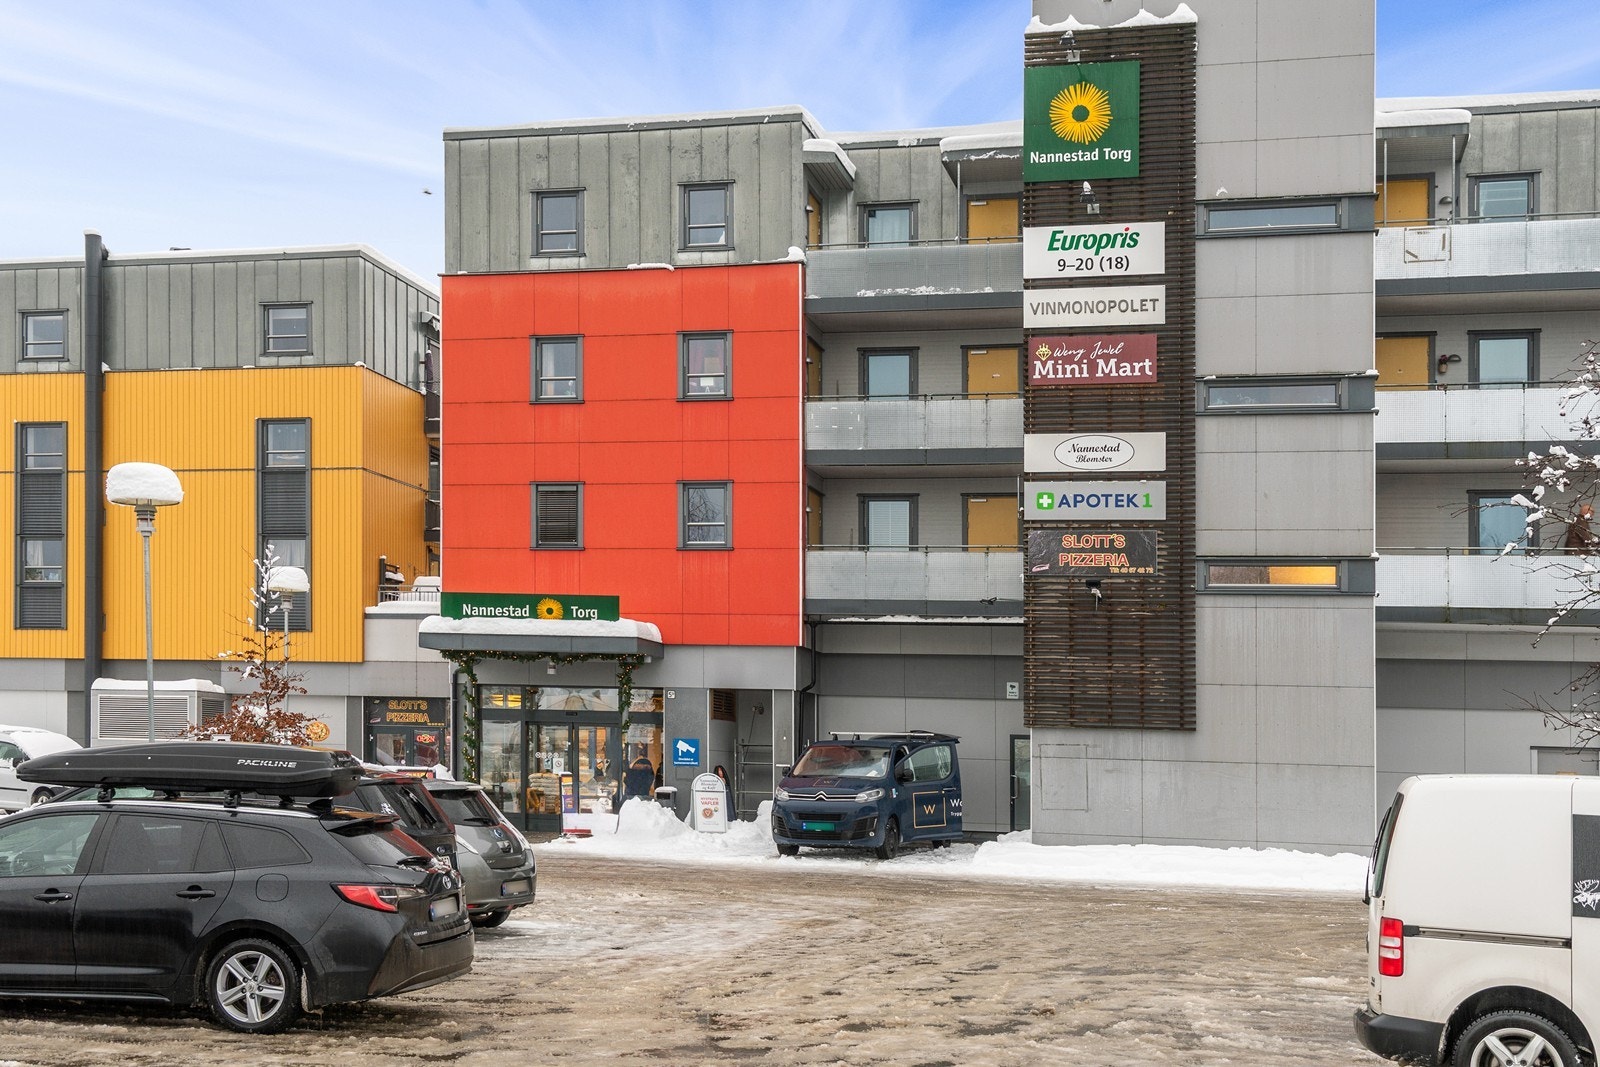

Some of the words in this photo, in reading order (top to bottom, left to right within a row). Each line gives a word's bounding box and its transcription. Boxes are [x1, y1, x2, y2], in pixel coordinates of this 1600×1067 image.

[1030, 148, 1099, 163] Nannestad
[1103, 148, 1132, 162] Torg
[1047, 227, 1140, 256] Europris
[1099, 255, 1130, 272] (18)
[1029, 298, 1160, 316] VINMONOPOLET
[1090, 341, 1125, 359] Jewel
[1032, 359, 1089, 379] Mini
[1095, 358, 1153, 378] Mart
[1068, 443, 1121, 454] Nannestad
[1075, 454, 1113, 463] Blomster
[1057, 493, 1140, 508] APOTEK
[1142, 493, 1153, 508] 1
[1059, 553, 1130, 567] PIZZERIA
[462, 603, 530, 617] Nannestad
[570, 606, 598, 620] Torg
[386, 712, 430, 722] PIZZERIA
[416, 735, 436, 743] OPEN
[237, 759, 297, 768] PACKLINE
[924, 804, 936, 814] W
